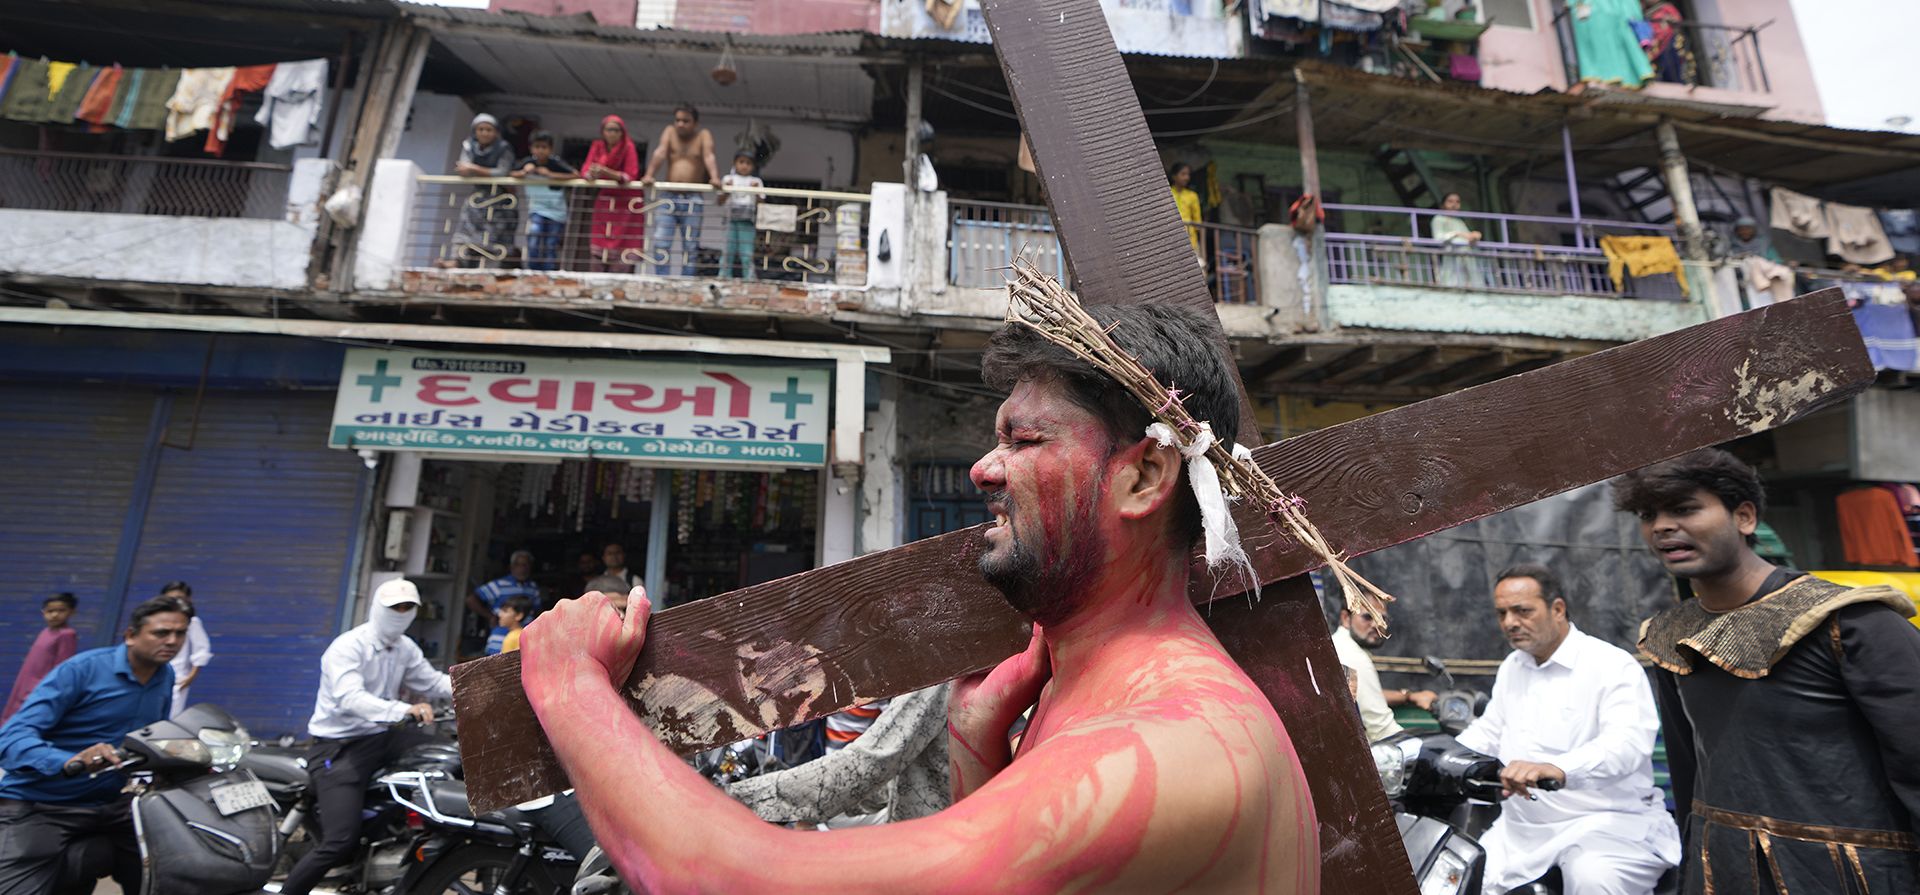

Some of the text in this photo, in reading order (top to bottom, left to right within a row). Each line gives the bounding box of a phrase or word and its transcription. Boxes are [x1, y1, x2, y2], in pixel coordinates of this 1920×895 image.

[416, 371, 752, 418] દવાઓ
[354, 409, 807, 441] નાઈસ મેડીકલ સ્ટોર્સ
